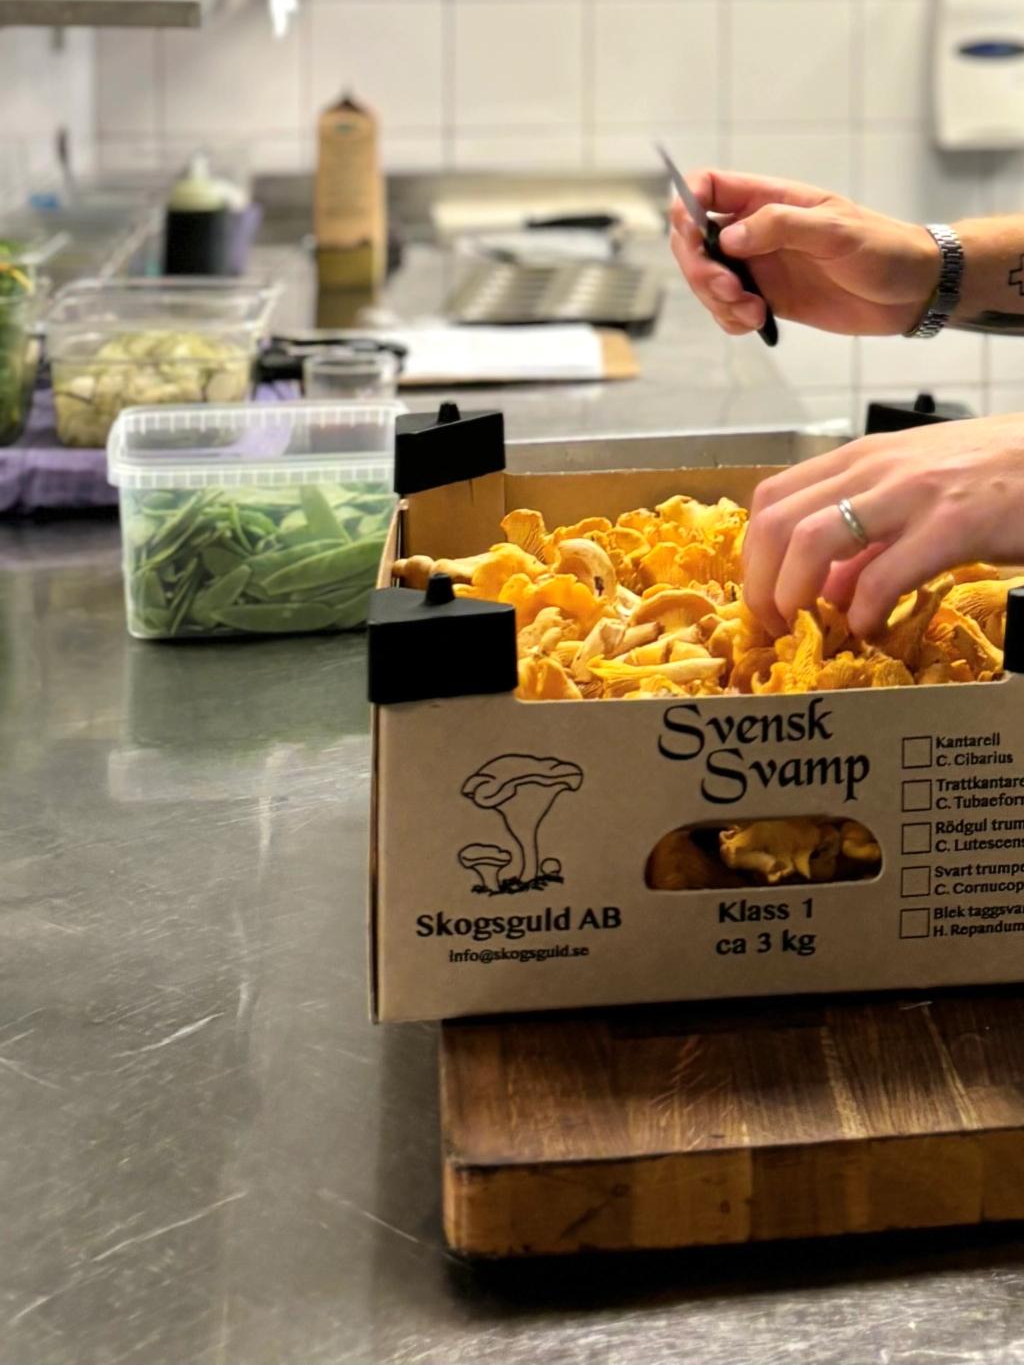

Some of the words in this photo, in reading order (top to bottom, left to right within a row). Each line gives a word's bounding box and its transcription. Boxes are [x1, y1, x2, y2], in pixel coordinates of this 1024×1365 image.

[657, 697, 834, 761] Svensk
[936, 732, 1000, 749] Kantarell
[936, 754, 951, 767] C.
[954, 751, 1013, 766] Cibarius
[700, 748, 871, 805] Svamp
[936, 797, 951, 810] C.
[936, 819, 987, 835] Rödgul
[935, 840, 950, 853] C.
[934, 865, 973, 878] Svart
[934, 884, 949, 896] C.
[718, 899, 790, 923] Klass
[801, 897, 813, 919] 1
[934, 906, 965, 920] Blek
[416, 906, 571, 941] Skogsguld
[578, 907, 623, 931] AB
[933, 925, 948, 937] H.
[951, 921, 1024, 937] Repandum
[715, 938, 747, 955] ca
[756, 932, 772, 953] 3
[782, 929, 817, 956] kg
